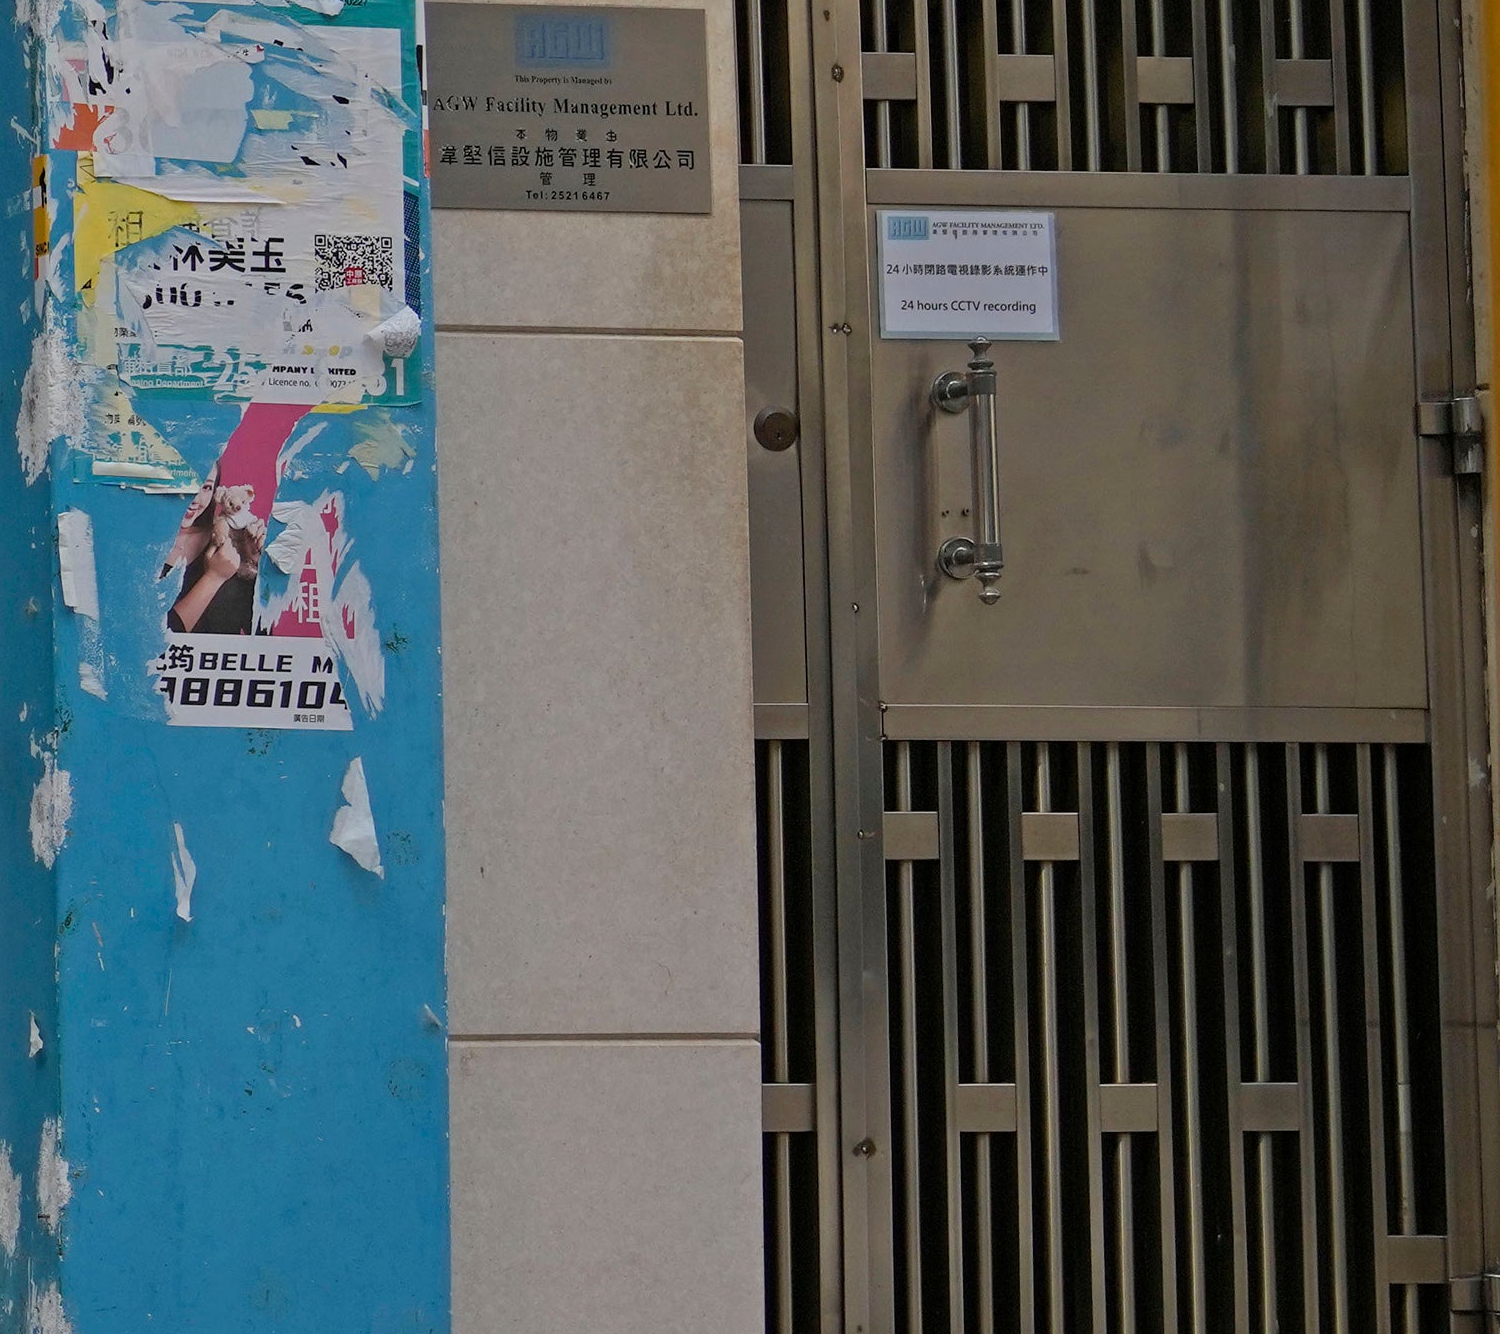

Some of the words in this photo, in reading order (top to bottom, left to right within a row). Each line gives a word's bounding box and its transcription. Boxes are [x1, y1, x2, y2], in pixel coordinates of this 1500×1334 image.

[514, 74, 530, 84] This
[531, 75, 562, 86] Property
[485, 96, 547, 117] Facility
[553, 97, 658, 118] Management
[665, 100, 699, 118] Ltd.
[901, 300, 915, 311] 24
[917, 300, 949, 312] hours
[950, 300, 981, 312] CCTV
[983, 300, 1037, 315] recording
[267, 377, 299, 388] Licence
[200, 652, 294, 674] BELLE
